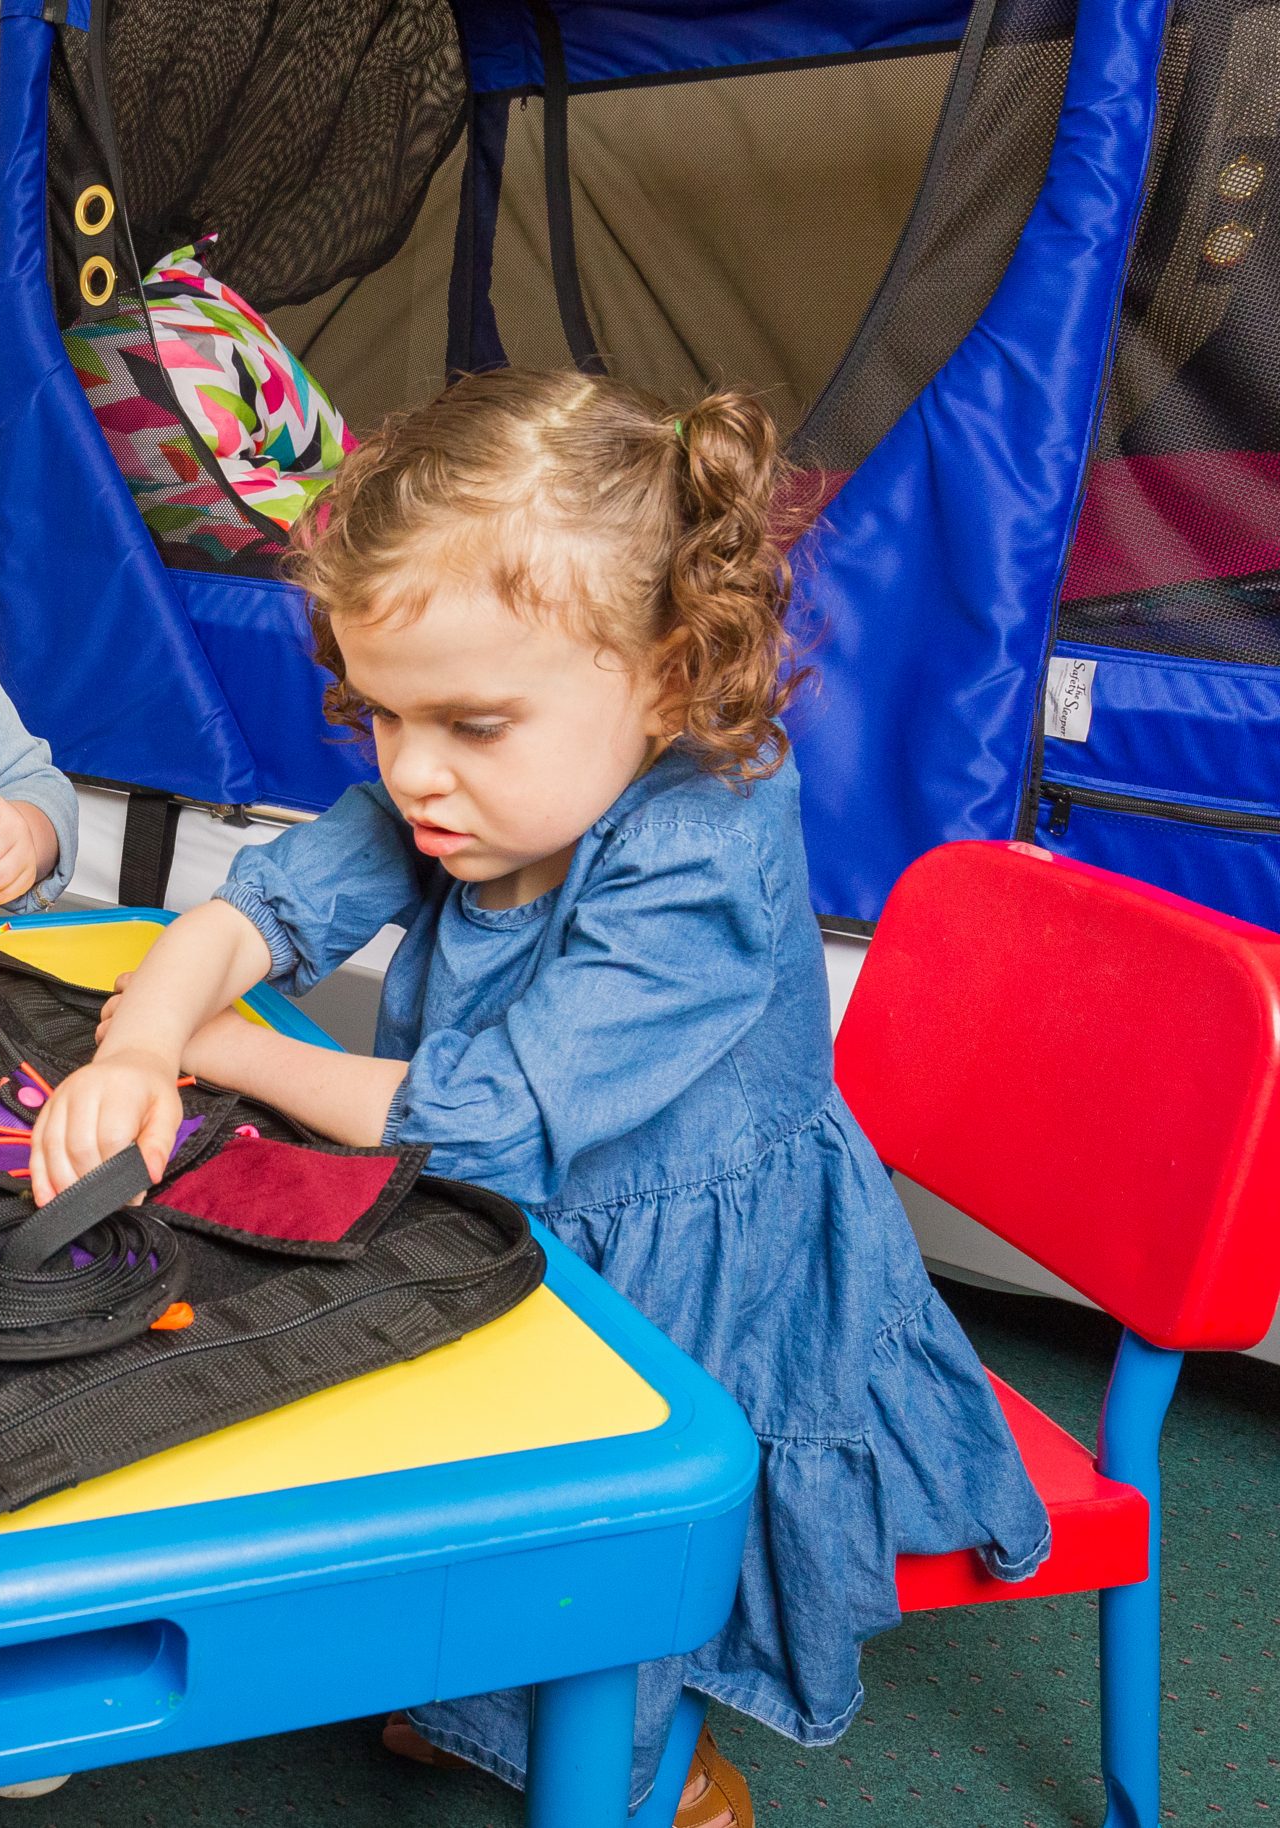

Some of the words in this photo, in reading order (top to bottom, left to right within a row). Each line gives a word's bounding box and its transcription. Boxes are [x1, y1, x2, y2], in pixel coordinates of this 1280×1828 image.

[1065, 660, 1086, 695] Safety
[1074, 684, 1087, 699] The
[1060, 698, 1079, 737] Sleeper
